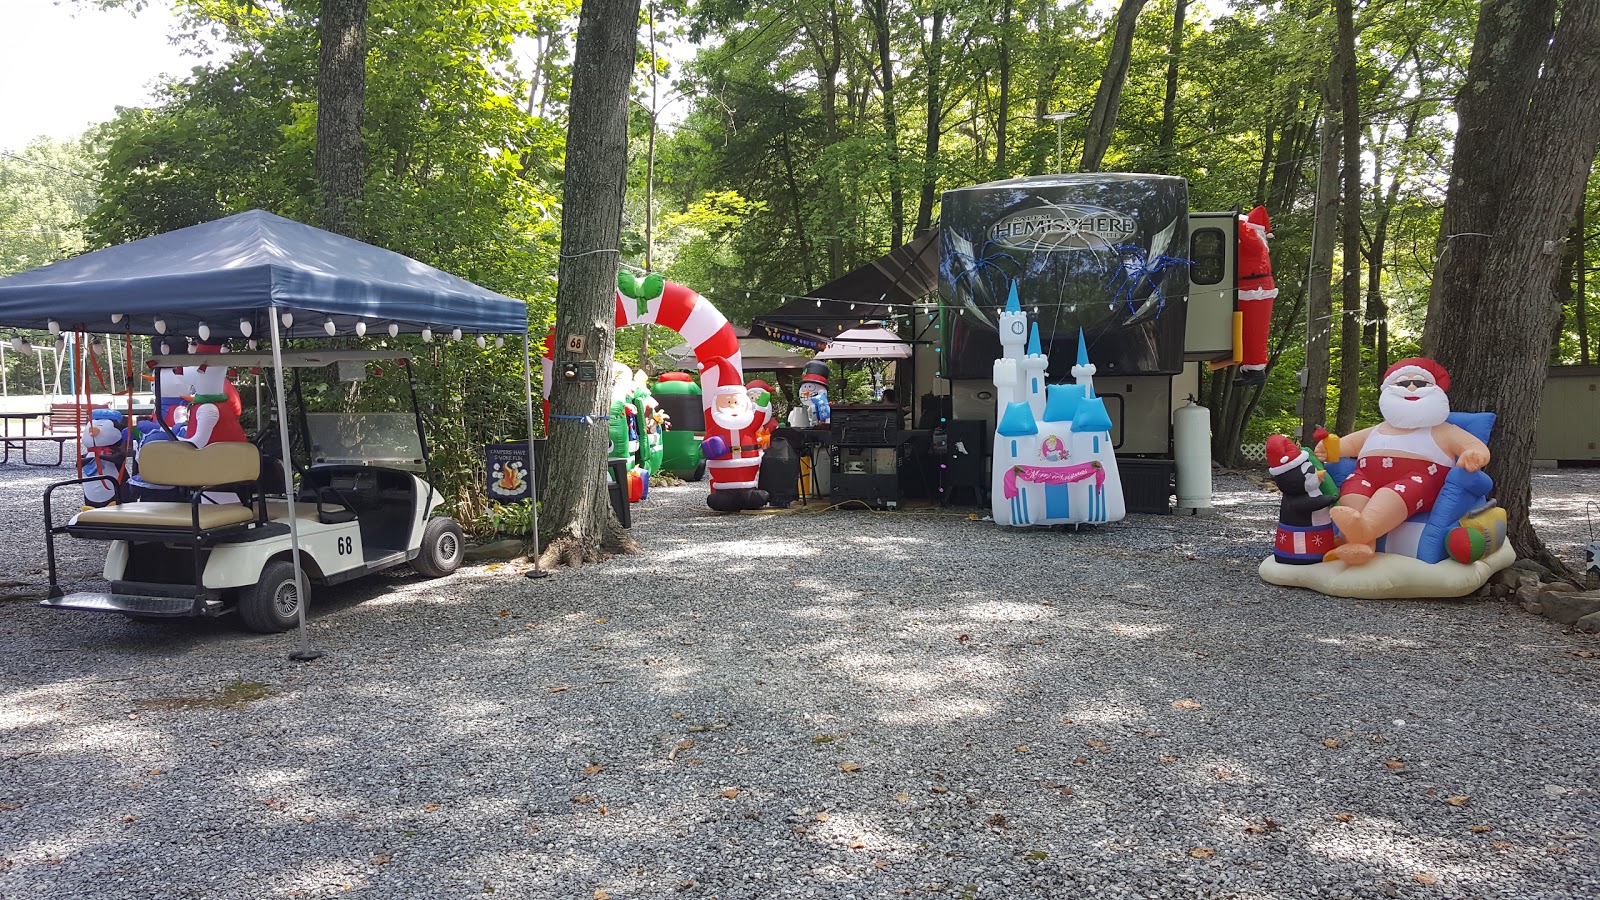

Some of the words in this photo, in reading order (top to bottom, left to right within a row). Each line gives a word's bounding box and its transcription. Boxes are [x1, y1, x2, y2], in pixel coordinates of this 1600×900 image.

[1012, 214, 1051, 223] SALEM
[995, 217, 1135, 238] HEMISPHERE
[570, 338, 582, 349] 68
[338, 536, 352, 555] 68
